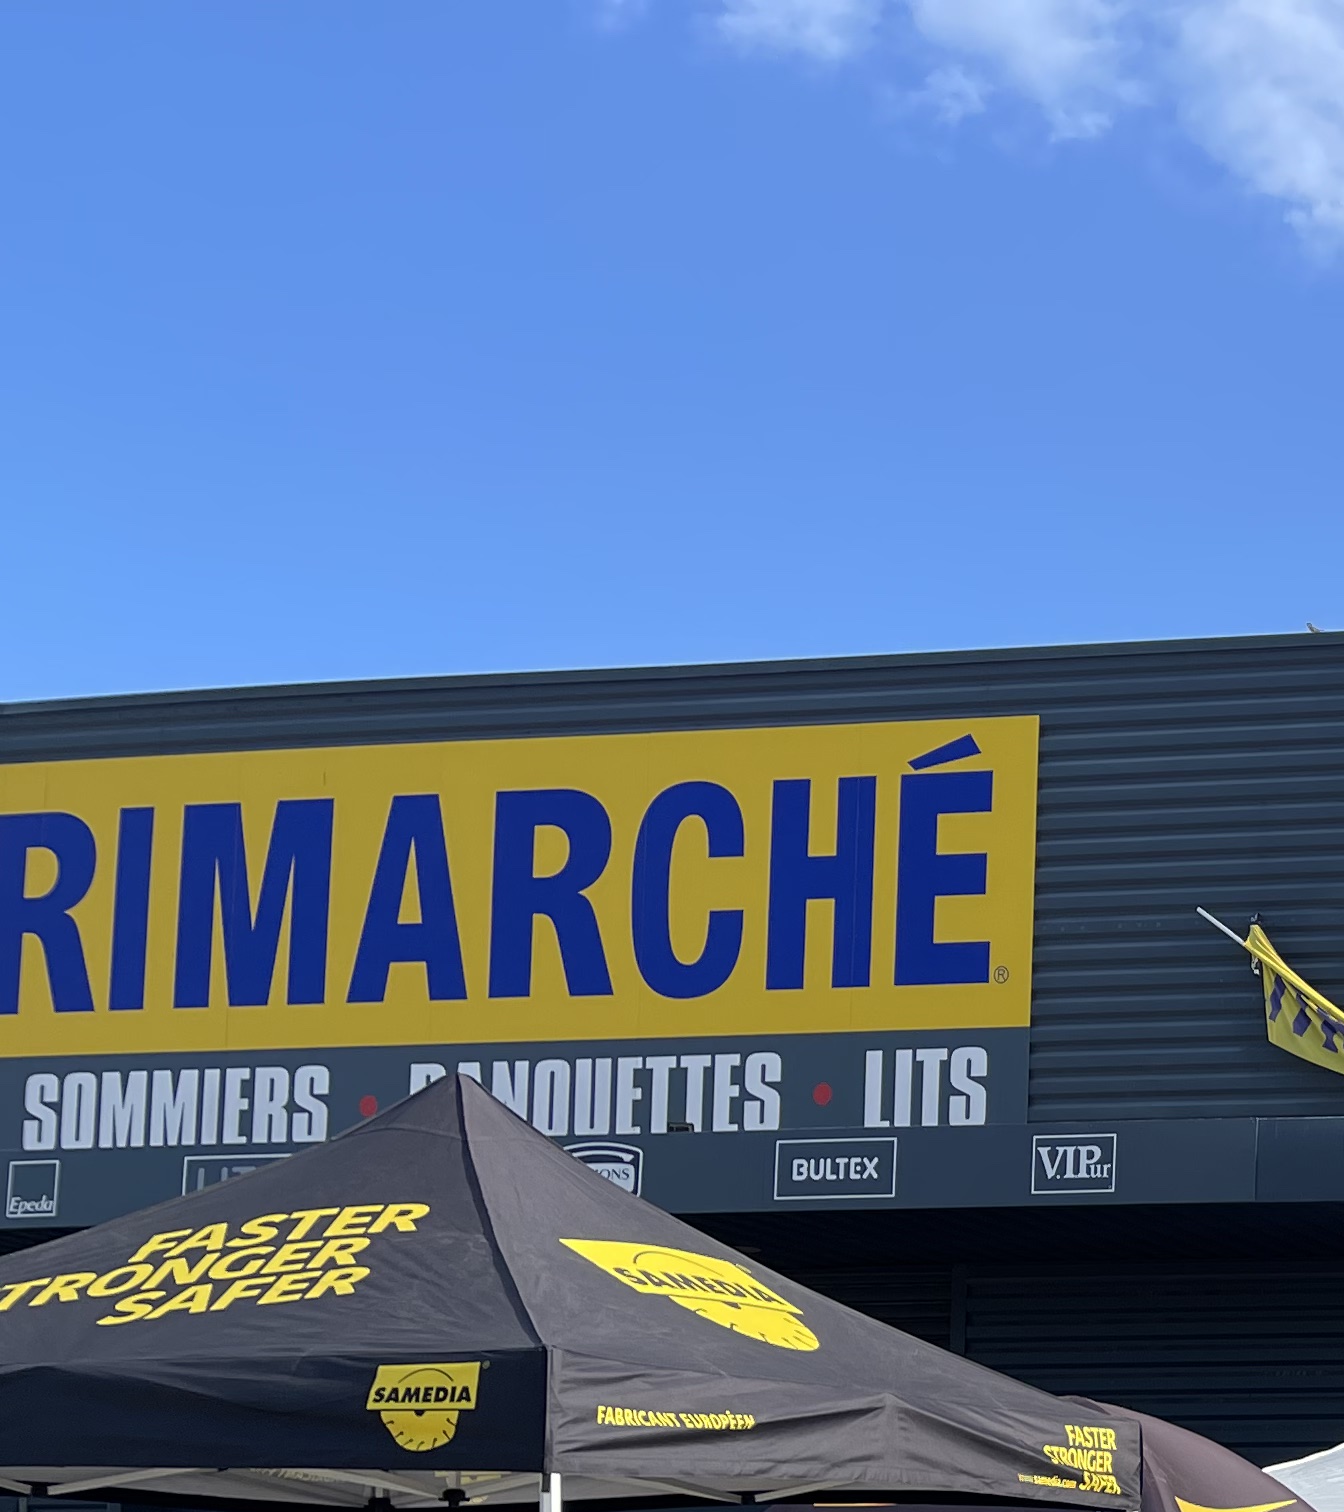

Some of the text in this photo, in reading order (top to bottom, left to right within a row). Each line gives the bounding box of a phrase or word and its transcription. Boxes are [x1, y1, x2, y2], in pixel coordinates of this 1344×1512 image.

[0, 733, 993, 1014] RIMARCHÉ
[22, 1046, 989, 1152] SOMMIERS NQUETTES LITS
[595, 1167, 630, 1181] ONS
[792, 1156, 879, 1182] BULTEX
[128, 1203, 430, 1263] FASTER
[0, 1237, 371, 1312] TRONGER
[612, 1266, 788, 1307] SAMEDIA
[96, 1266, 371, 1326] SAFER
[372, 1384, 472, 1405] SAMEDIA
[596, 1405, 681, 1428] FABRICANT
[1064, 1424, 1118, 1451] FASTER
[1042, 1444, 1113, 1473] STRONGER
[1078, 1470, 1122, 1496] SAFER
